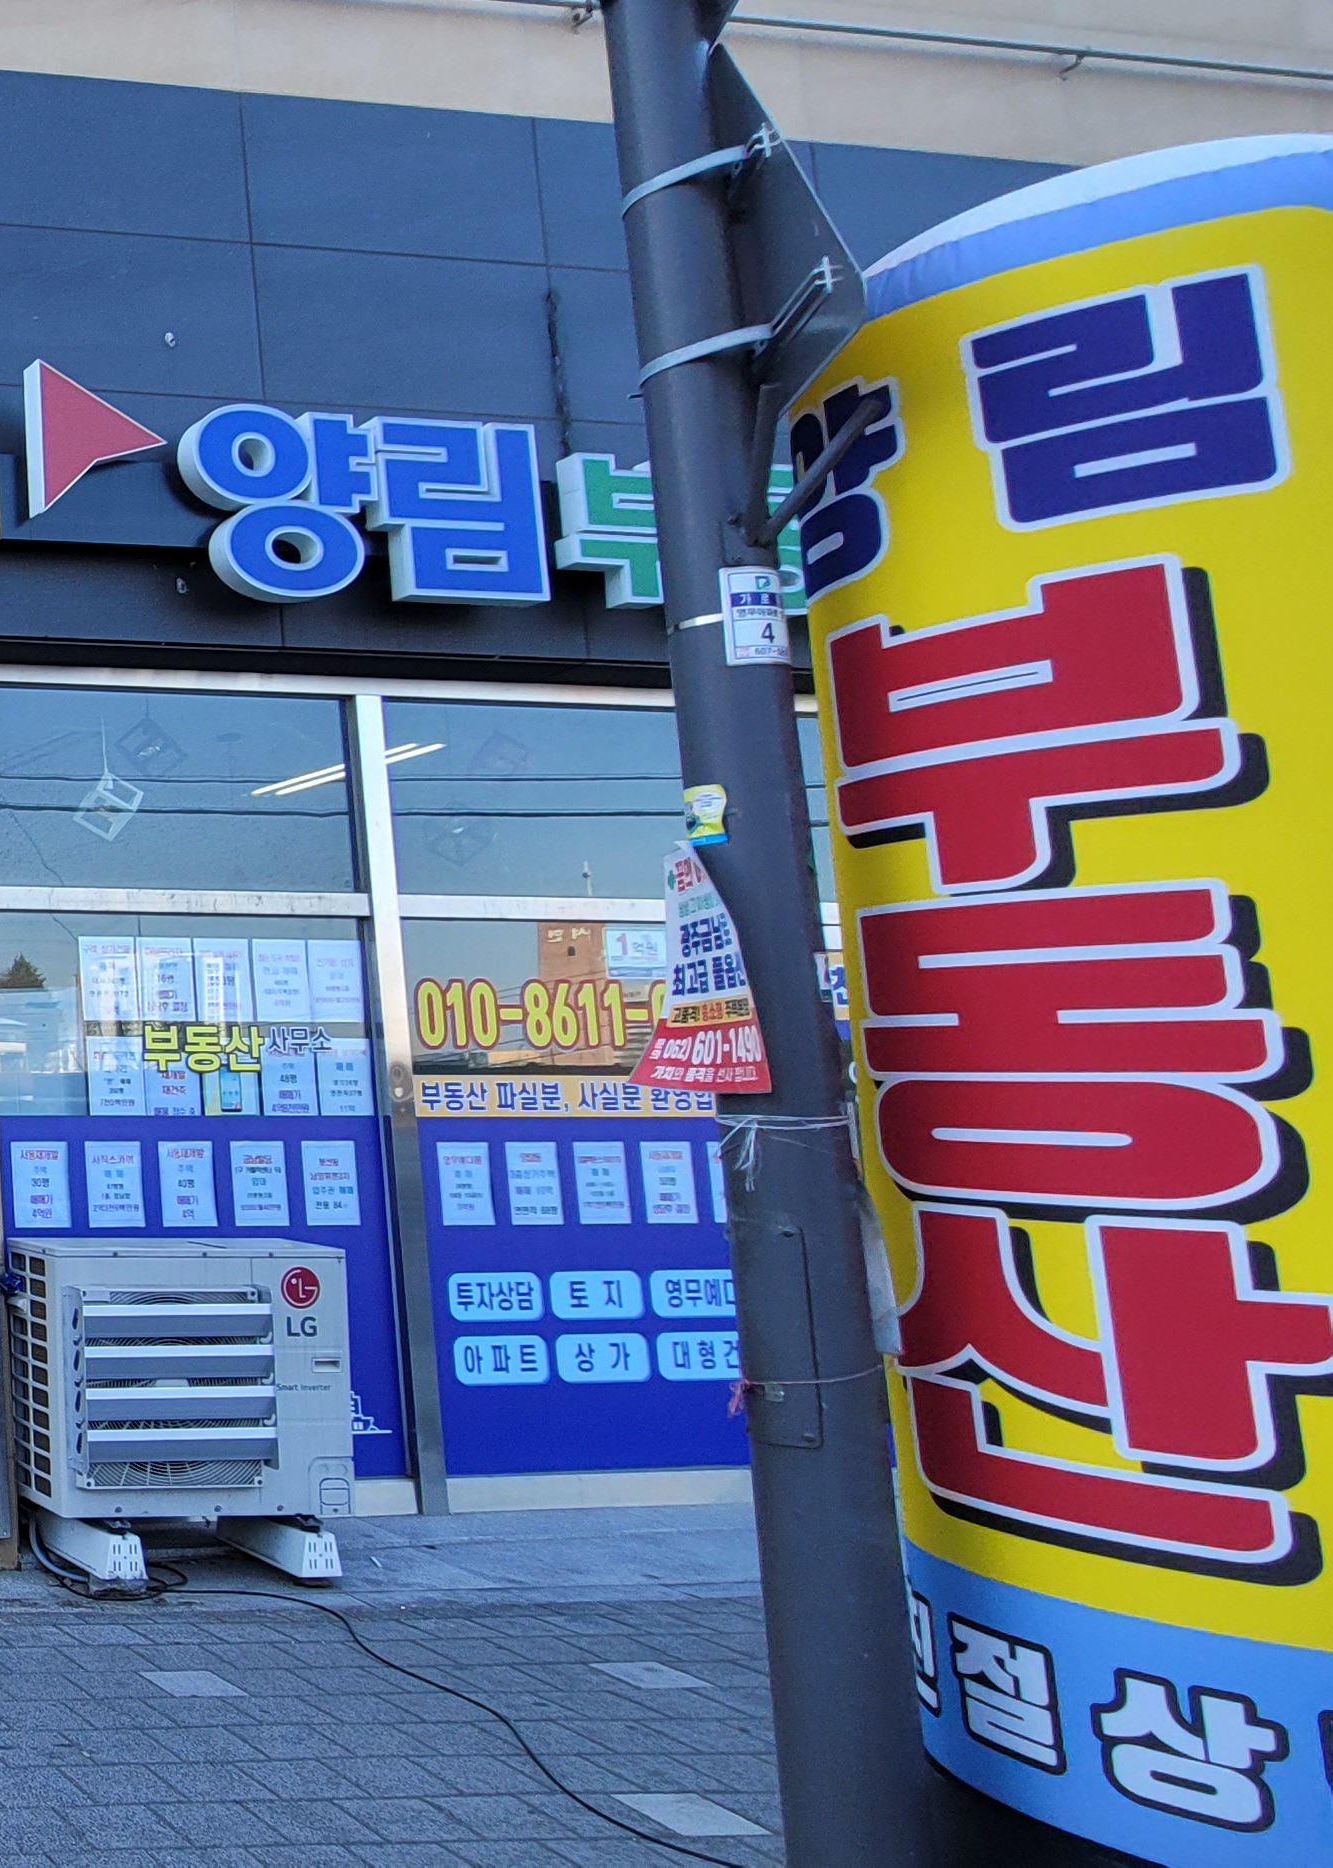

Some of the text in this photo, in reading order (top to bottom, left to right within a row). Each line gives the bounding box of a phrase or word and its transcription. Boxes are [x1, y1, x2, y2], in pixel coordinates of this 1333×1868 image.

[178, 403, 551, 606] 양림
[761, 622, 776, 644] 4
[142, 1023, 265, 1074] 부동산
[266, 1025, 333, 1055] 사무소
[421, 1081, 487, 1112] 부동산
[494, 1081, 569, 1113] 파실분,
[455, 1278, 535, 1311] 투자상담
[286, 1316, 318, 1338] LG
[276, 1382, 332, 1392] Smart Inverter
